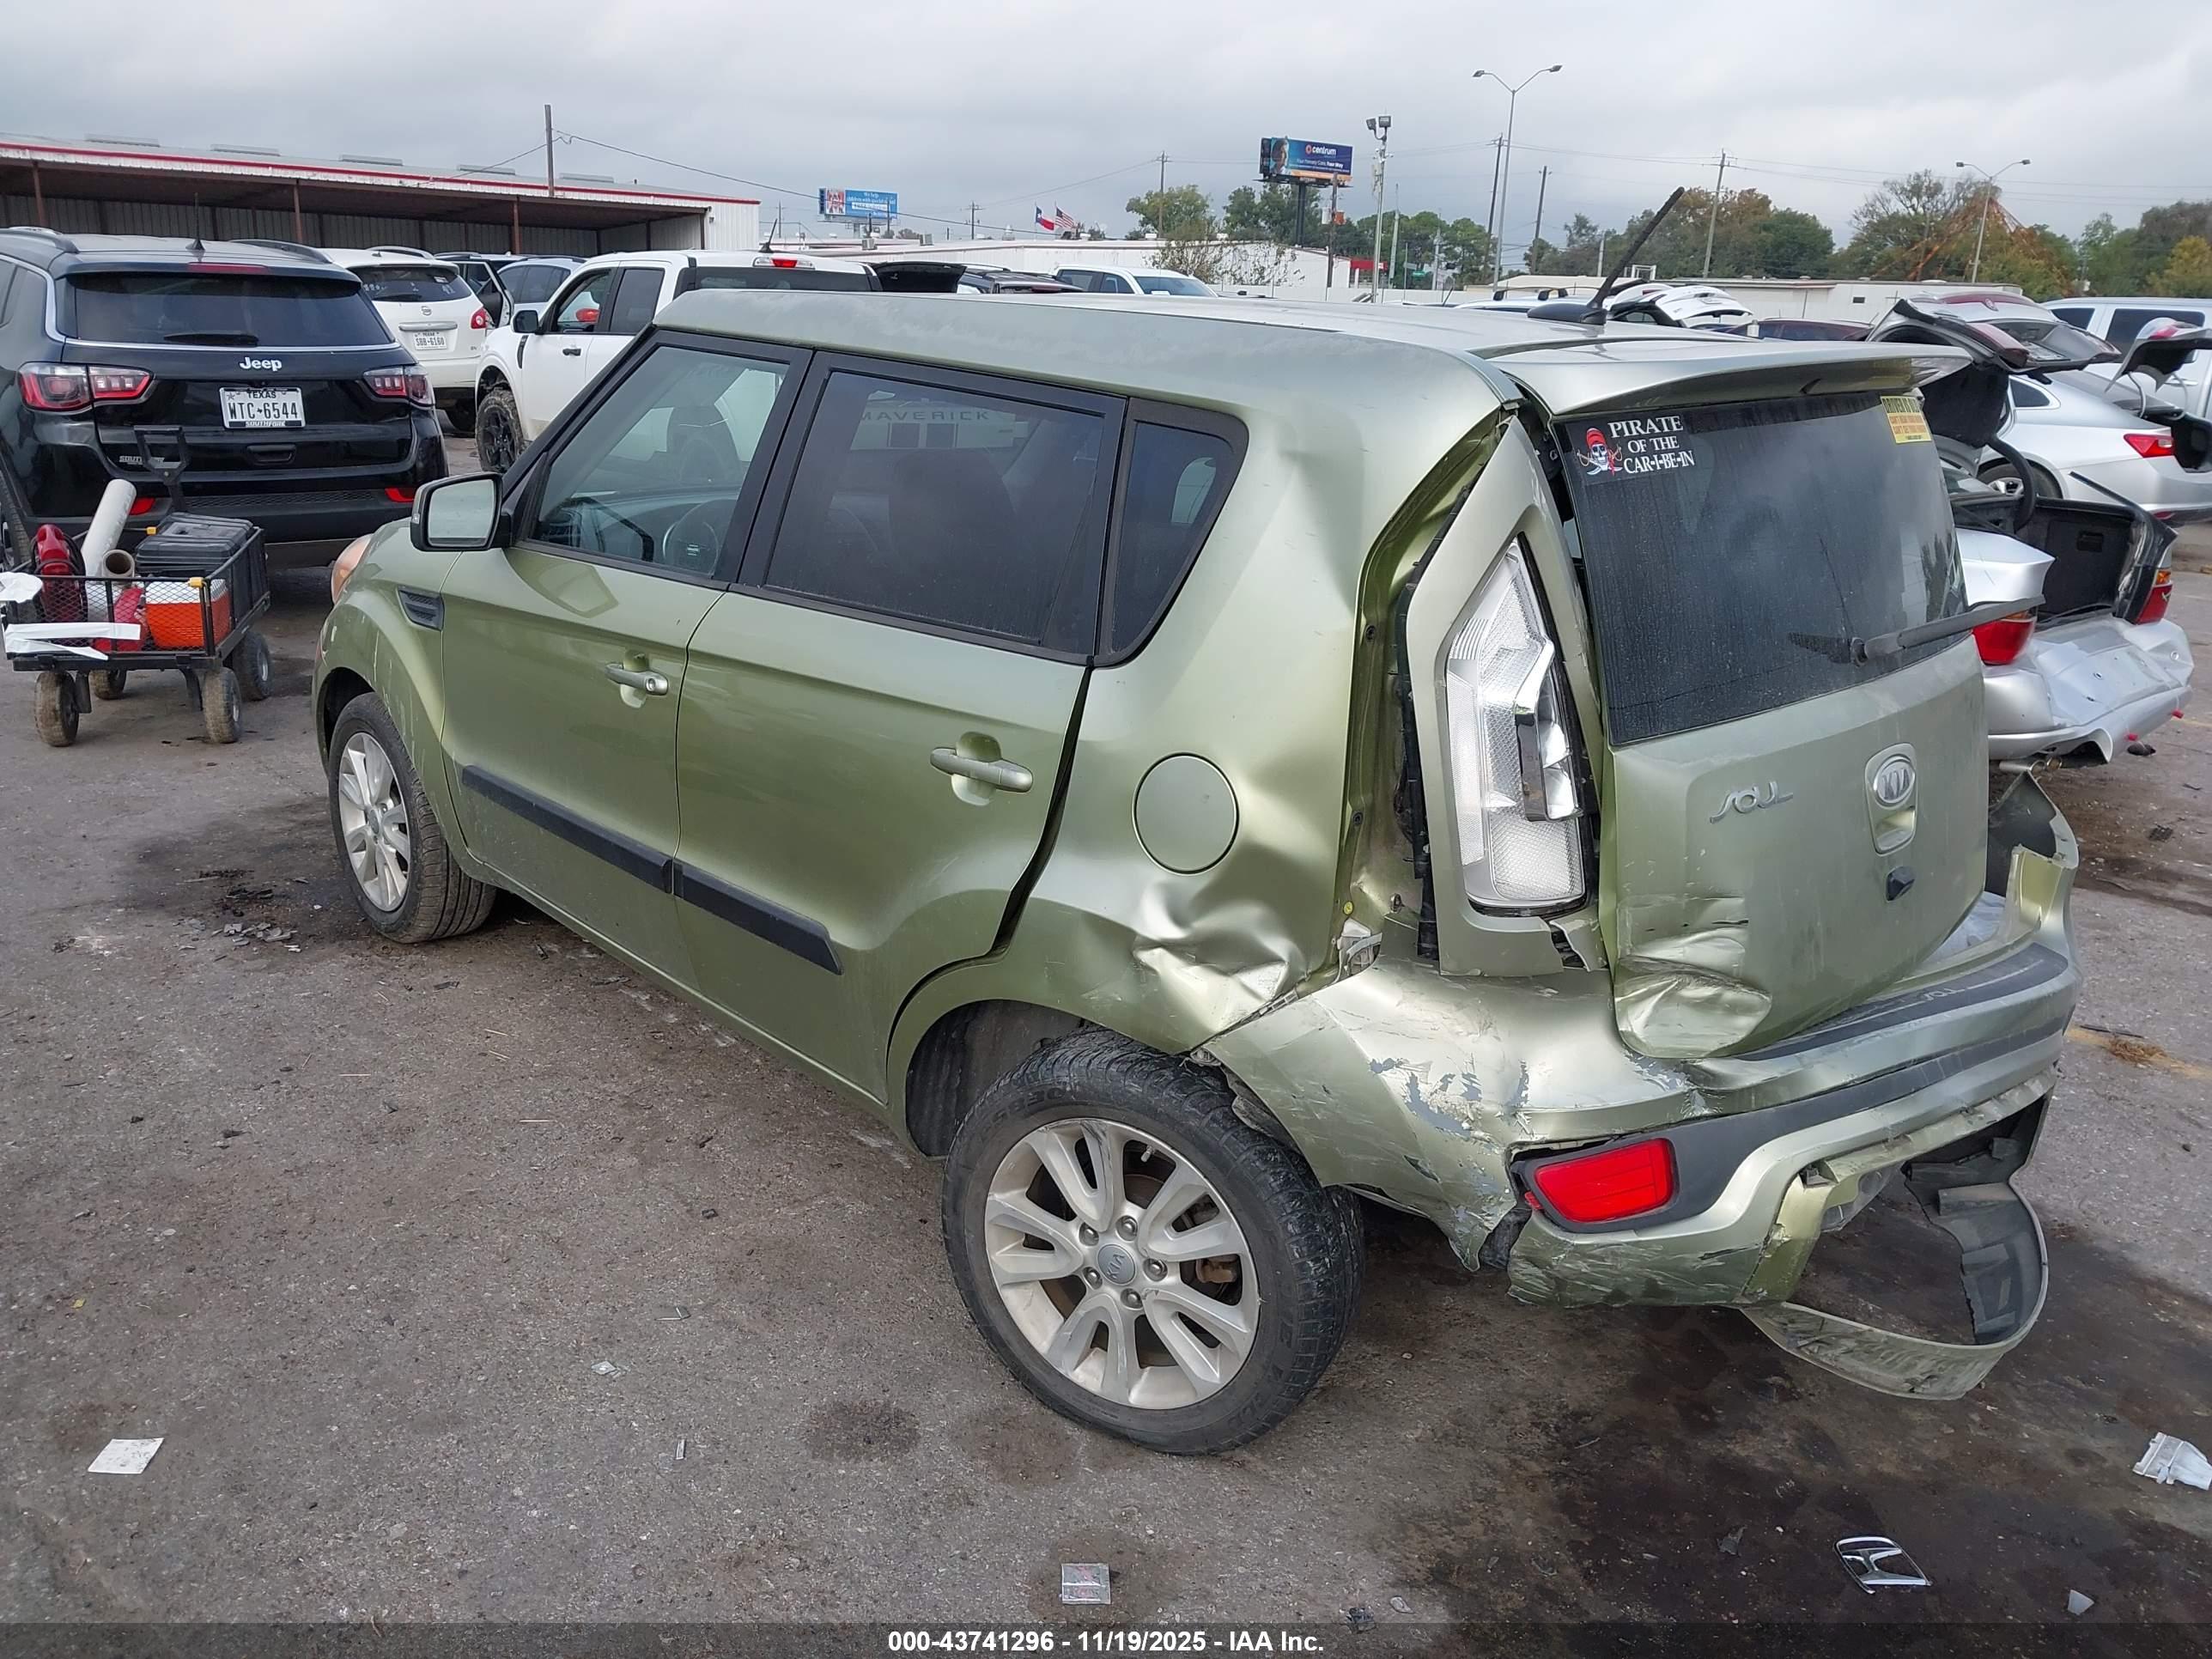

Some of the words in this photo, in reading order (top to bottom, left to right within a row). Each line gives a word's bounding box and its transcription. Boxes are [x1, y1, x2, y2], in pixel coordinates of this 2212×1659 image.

[1312, 145, 1336, 155] centrum
[240, 356, 282, 372] Jeep
[246, 391, 276, 399] TEXAS
[1607, 416, 1683, 438] PIRATE
[1627, 439, 1646, 453] OF
[1650, 436, 1680, 451] THE
[1881, 768, 1911, 800] KIA
[1107, 1254, 1125, 1279] KIA
